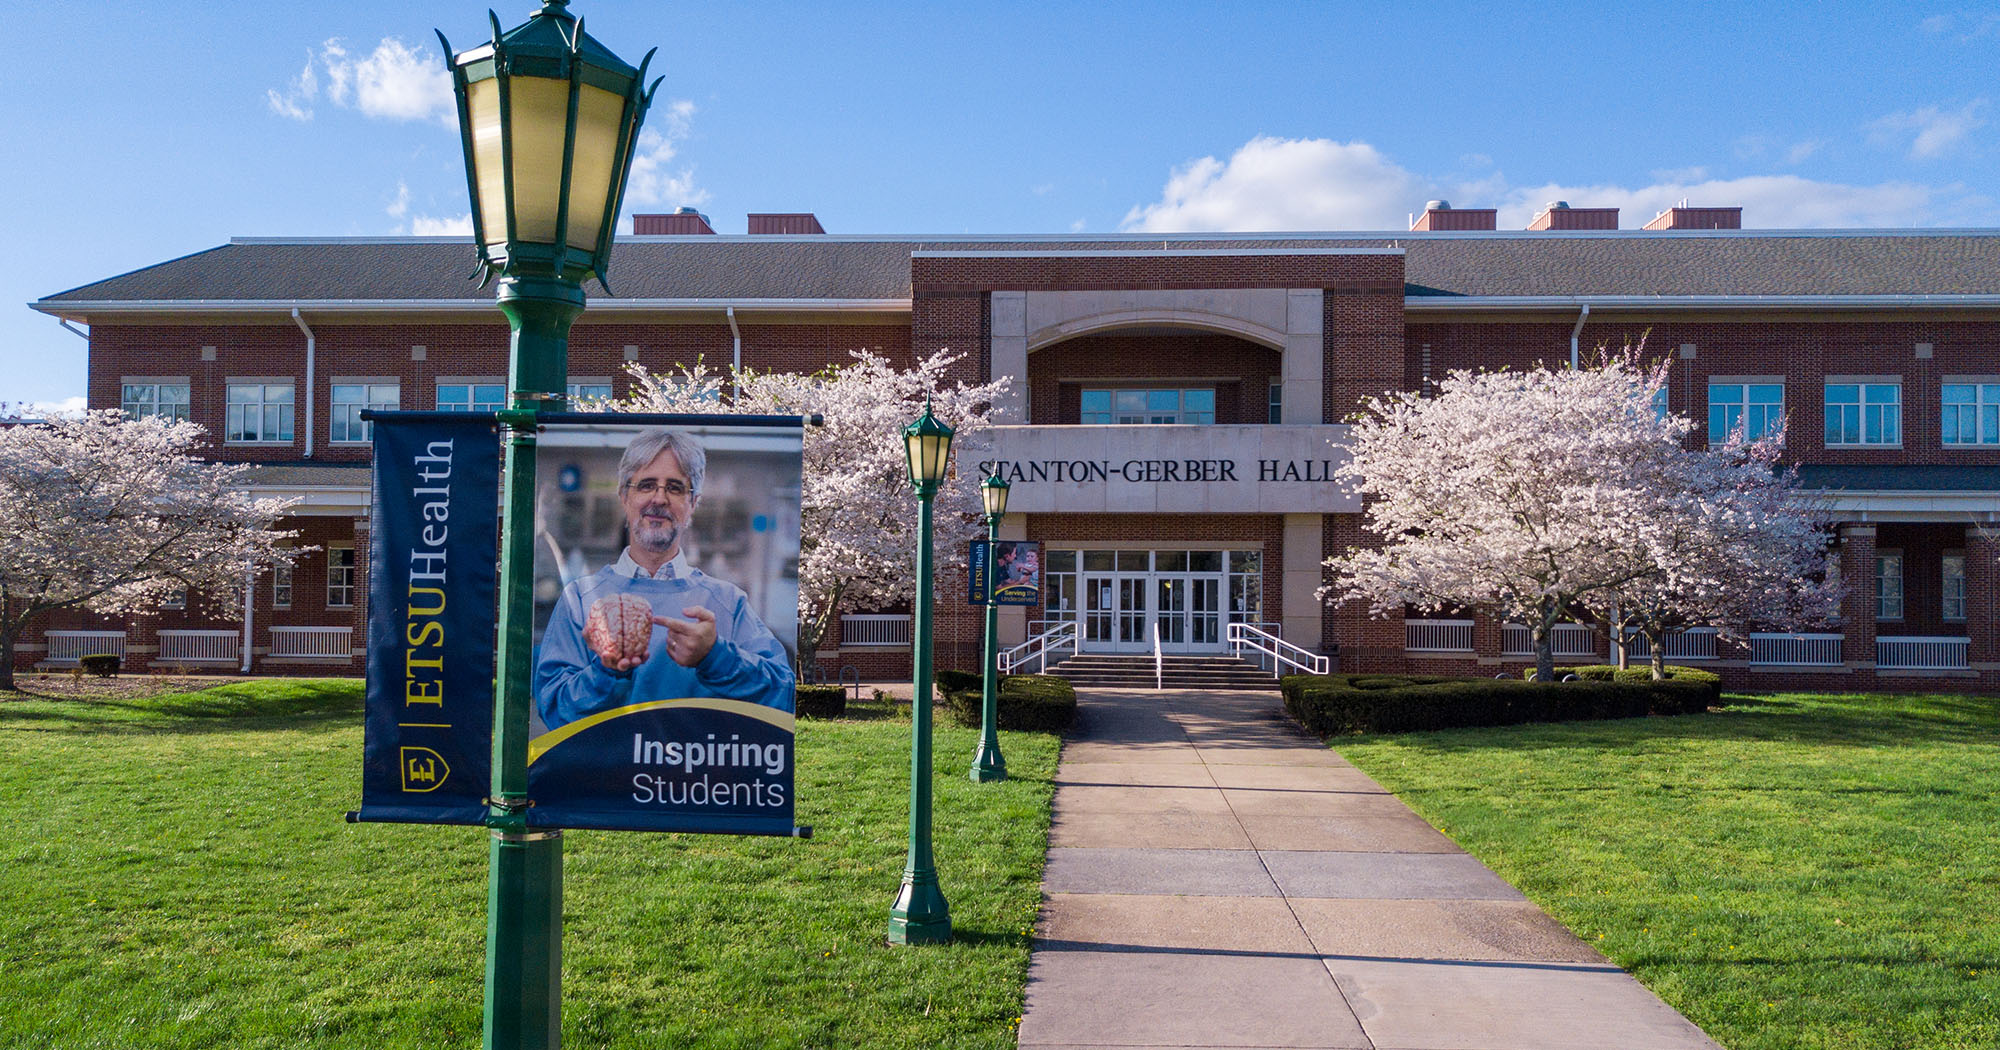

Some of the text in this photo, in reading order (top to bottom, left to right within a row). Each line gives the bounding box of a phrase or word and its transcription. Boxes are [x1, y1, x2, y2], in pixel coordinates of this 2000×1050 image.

[1257, 460, 1336, 482] HALL
[633, 733, 785, 775] Inspiring
[633, 773, 785, 807] Students
